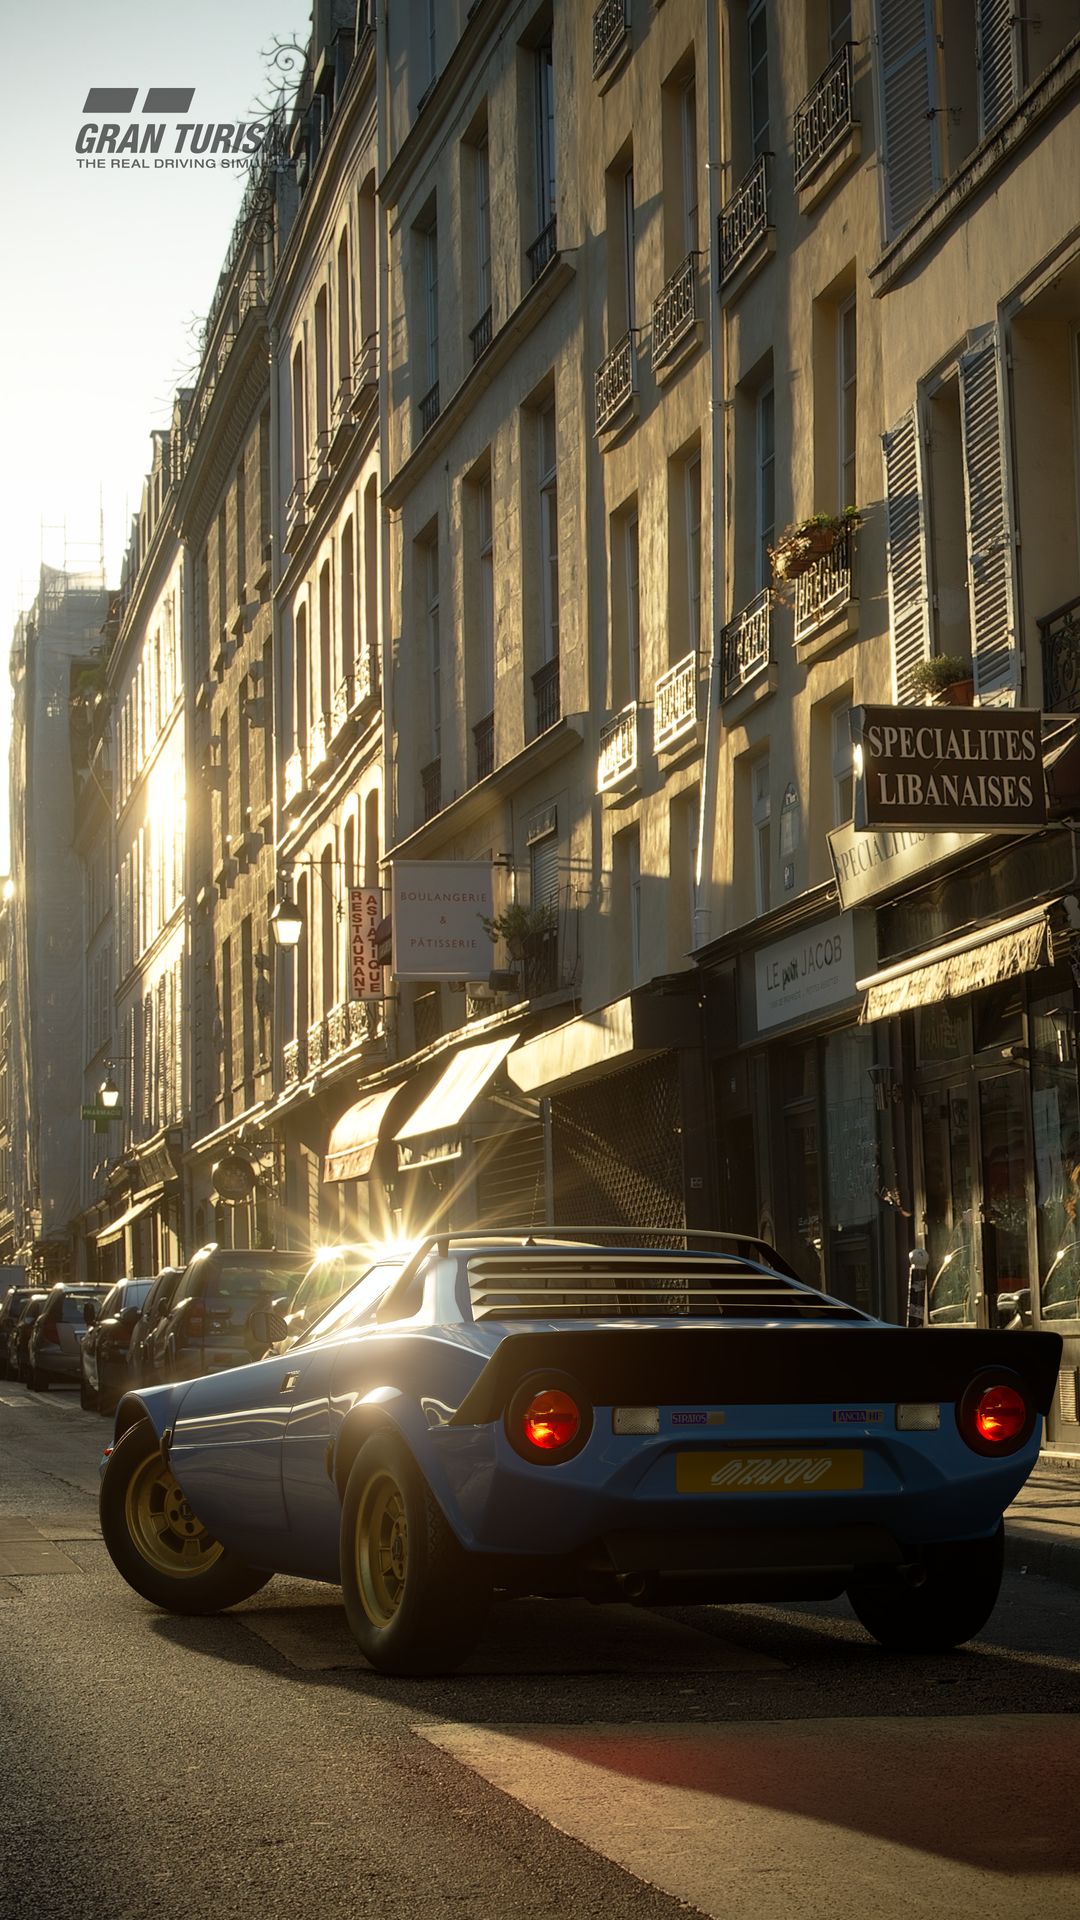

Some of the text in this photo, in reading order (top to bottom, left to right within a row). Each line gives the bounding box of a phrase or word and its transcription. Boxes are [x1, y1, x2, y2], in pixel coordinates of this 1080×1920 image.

[868, 726, 1036, 761] SPECIALITES
[877, 773, 1034, 808] LIBANAISES
[834, 832, 927, 887] SPECIALIT
[400, 891, 488, 903] BOULANGERIE
[439, 915, 447, 925] &
[351, 891, 366, 998] RESTAURANT
[366, 895, 381, 993] ASIATIQUE
[766, 961, 780, 991] LE
[801, 935, 842, 977] JACOB
[672, 1414, 706, 1424] STRATOS
